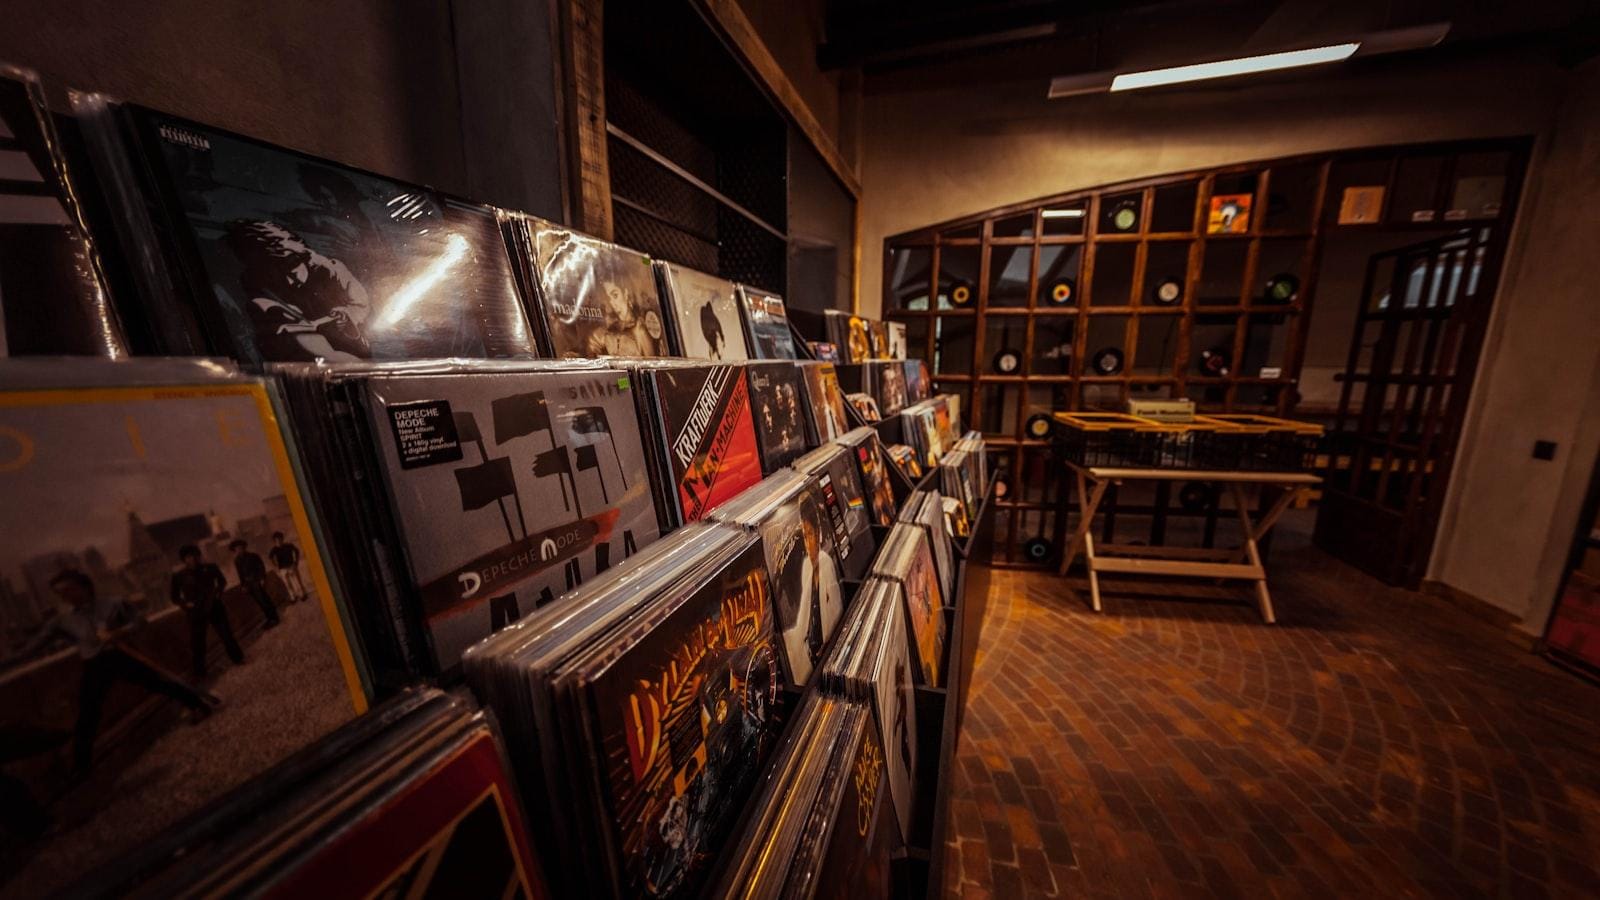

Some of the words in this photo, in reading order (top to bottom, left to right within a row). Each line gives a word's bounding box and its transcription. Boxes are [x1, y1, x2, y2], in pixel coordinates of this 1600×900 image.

[394, 407, 440, 420] DEPECHE
[396, 417, 426, 428] MODE
[675, 380, 719, 469] KRAFTWERK
[458, 547, 538, 600] DEPECHE
[541, 531, 581, 562] MODE
